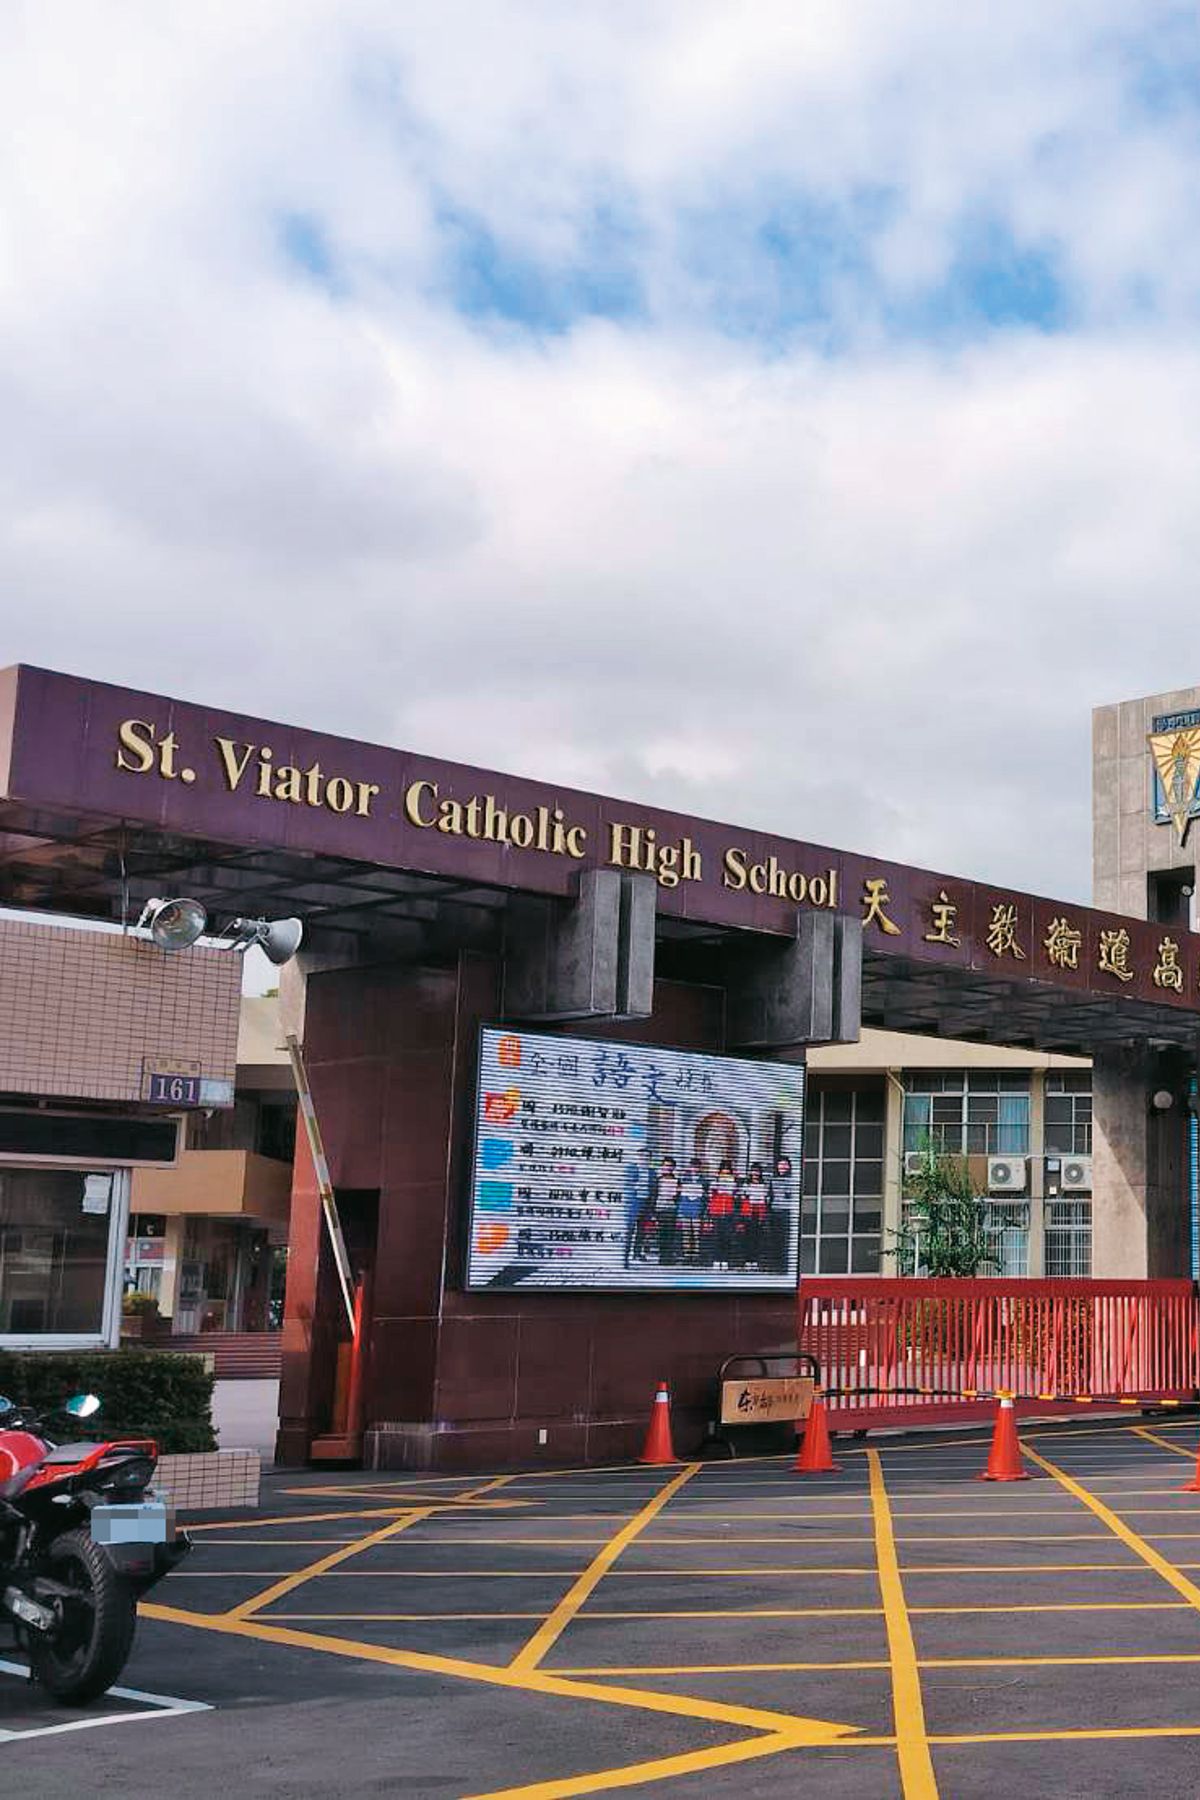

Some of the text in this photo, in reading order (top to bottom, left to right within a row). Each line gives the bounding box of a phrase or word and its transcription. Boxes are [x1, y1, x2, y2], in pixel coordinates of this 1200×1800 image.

[116, 719, 839, 909] St. Viator Catholic High School
[157, 1078, 195, 1102] 161
